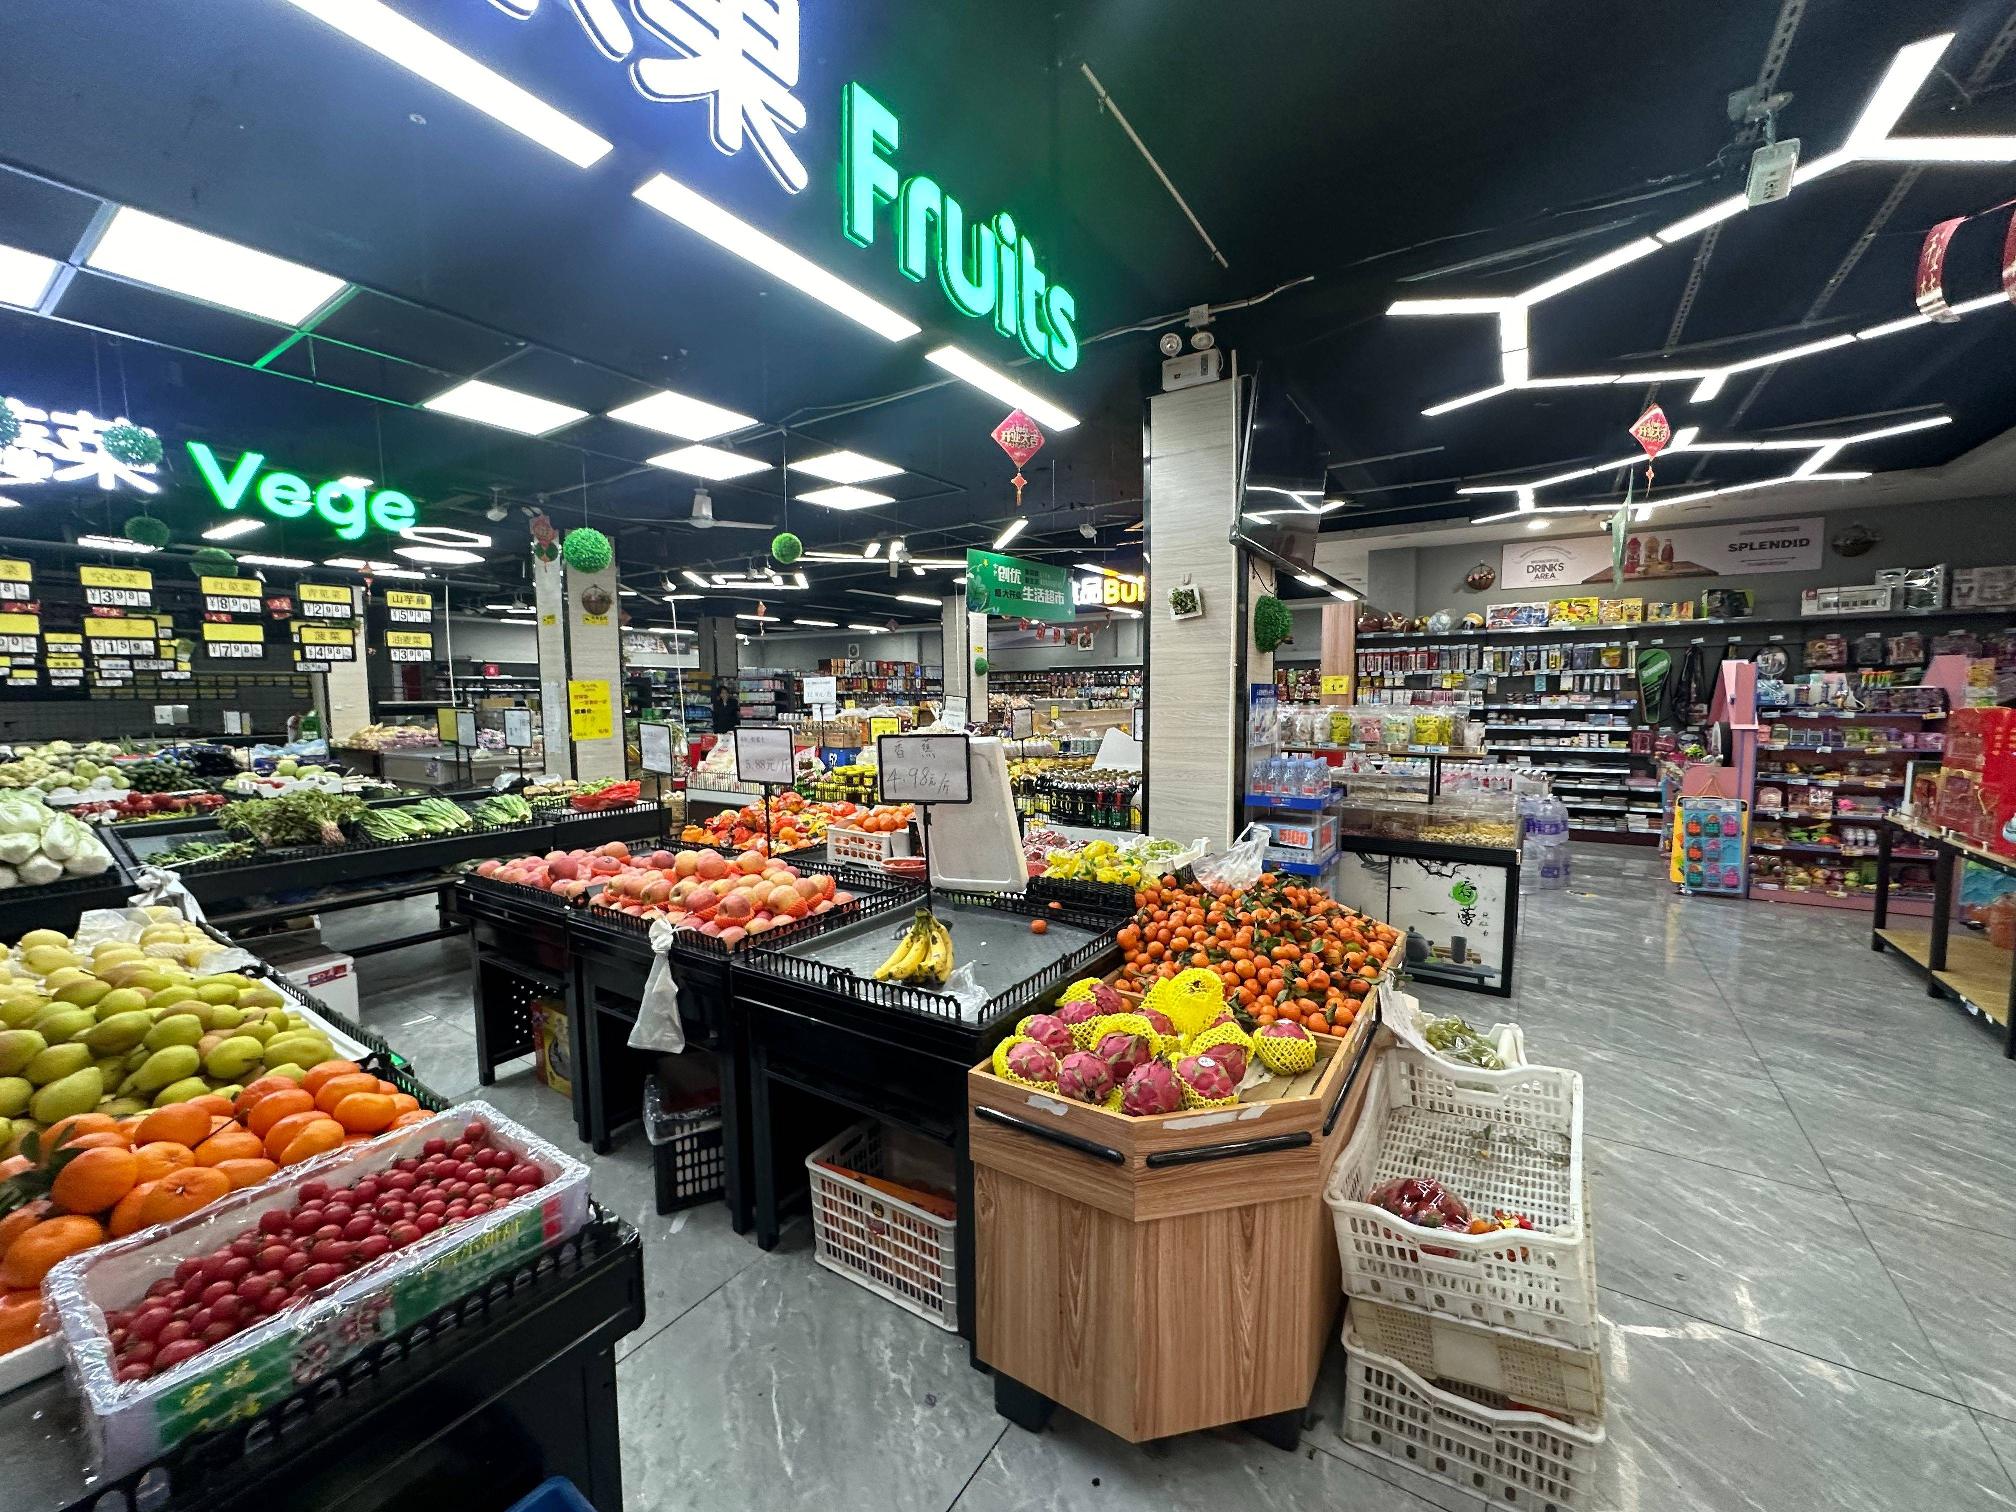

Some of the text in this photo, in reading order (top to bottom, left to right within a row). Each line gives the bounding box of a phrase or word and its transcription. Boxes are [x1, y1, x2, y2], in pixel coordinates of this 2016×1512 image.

[842, 82, 1079, 373] Fruits
[187, 440, 416, 541] Vege
[1727, 537, 1811, 553] SPLENDID
[1526, 562, 1565, 574] DRINKS
[1534, 572, 1556, 580] AREA
[1022, 585, 1065, 606] 生活超市
